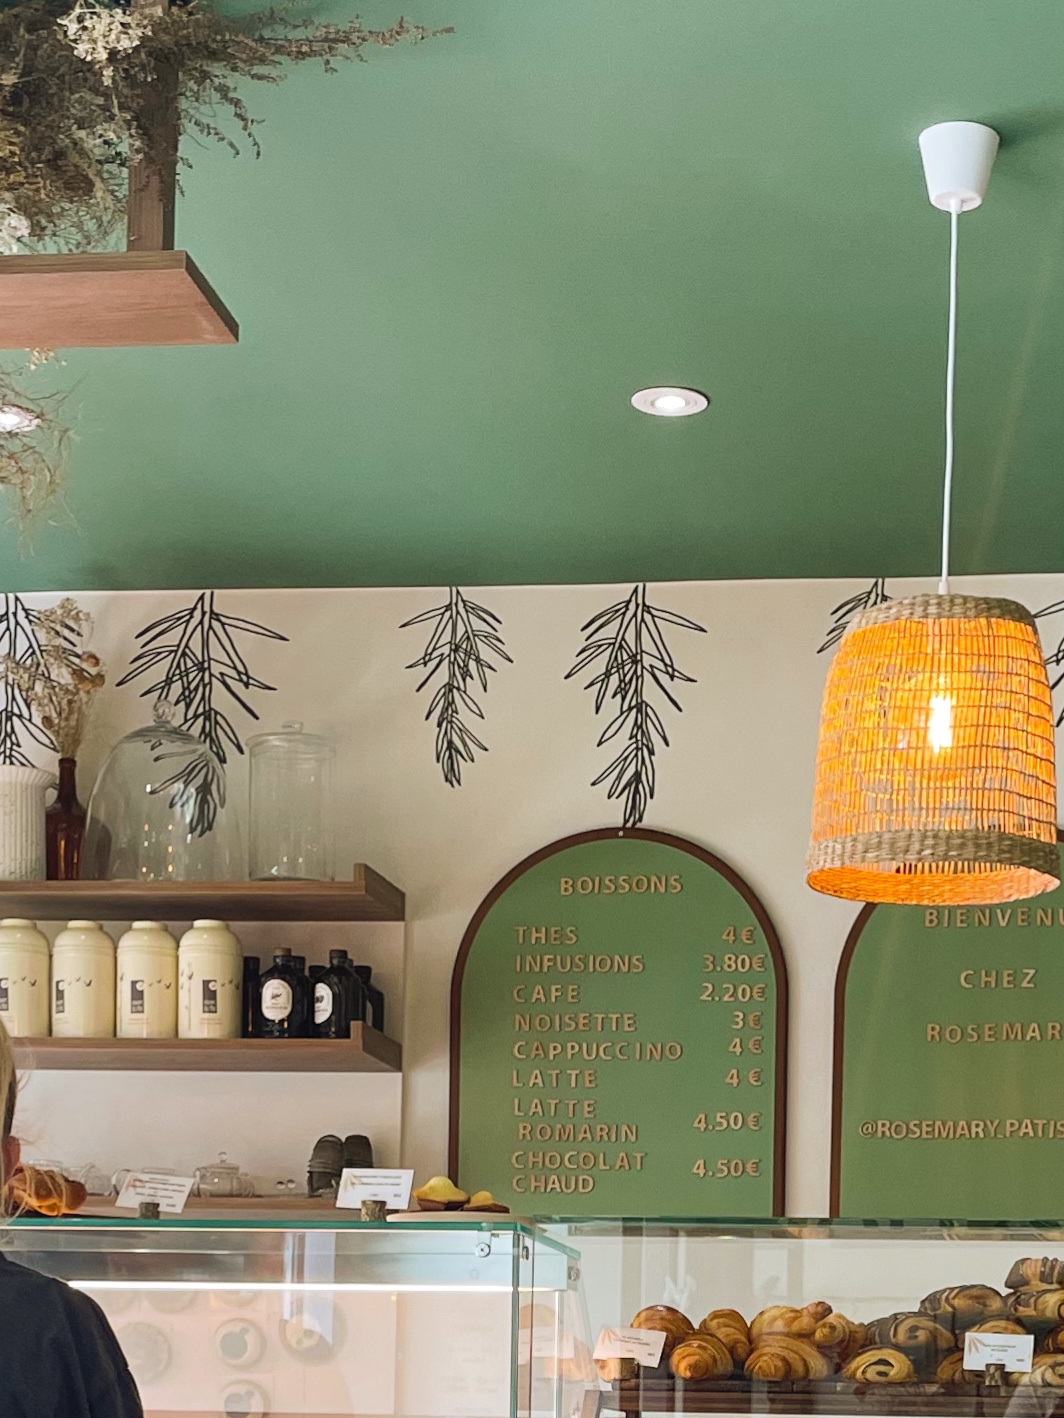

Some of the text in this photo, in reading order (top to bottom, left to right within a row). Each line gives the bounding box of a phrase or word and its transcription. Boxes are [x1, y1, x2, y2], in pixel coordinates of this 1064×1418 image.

[561, 875, 682, 895] BOISSONS
[515, 926, 578, 945] THES
[515, 954, 765, 973] INFUSIONS 3.80€
[960, 968, 1036, 990] CHEZ
[514, 983, 765, 1003] CAFE 2.20€
[514, 1013, 636, 1032] NOISETTE
[513, 1042, 682, 1060] CAPPUCCINO
[513, 1070, 596, 1088] LATTE
[514, 1098, 595, 1118] LATTE
[518, 1112, 760, 1142] ROMARIN 4.50€
[512, 1152, 759, 1178] CHOCOLAT 4.50€
[513, 1175, 593, 1193] CHAUD
